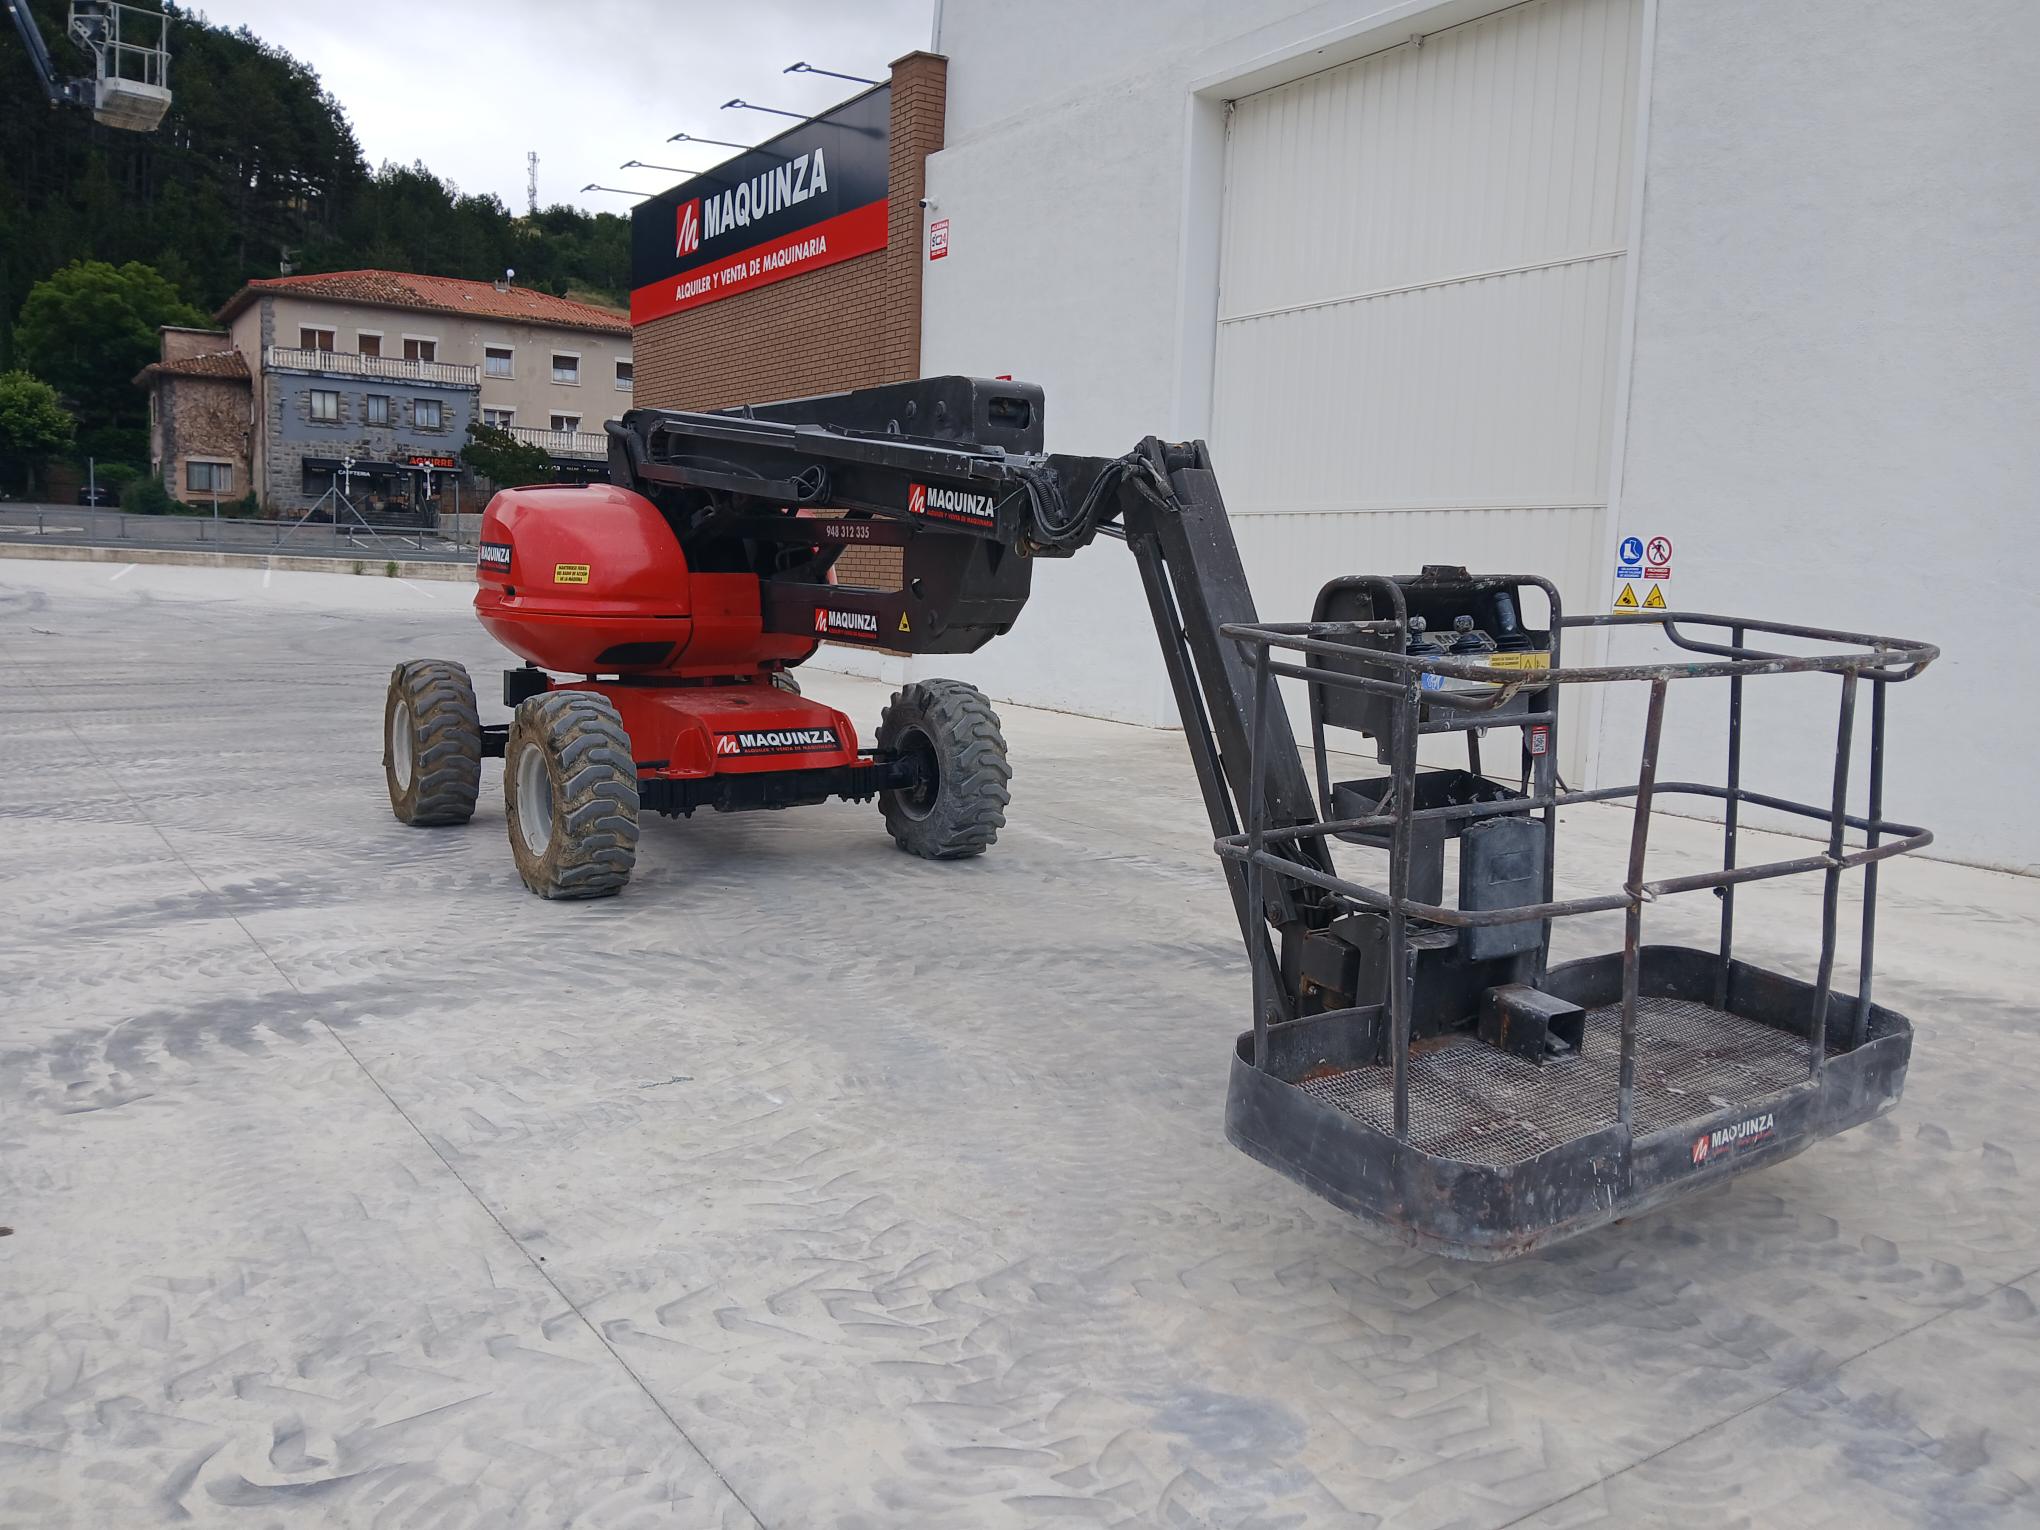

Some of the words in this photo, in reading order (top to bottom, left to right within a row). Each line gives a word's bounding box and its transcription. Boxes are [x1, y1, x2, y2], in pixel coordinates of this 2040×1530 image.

[704, 148, 828, 240] MAQUINZA
[676, 275, 711, 301] ALQUILER
[713, 272, 719, 289] Y
[720, 264, 747, 286] VENTA
[750, 258, 761, 276] DE
[763, 235, 827, 273] MAQUINARIA
[927, 487, 994, 518] MAQUINZA
[826, 525, 839, 538] 948
[841, 526, 854, 538] 312
[856, 526, 870, 538] 335
[828, 611, 877, 631] MAQUINZA
[740, 730, 835, 748] MAQUINZA
